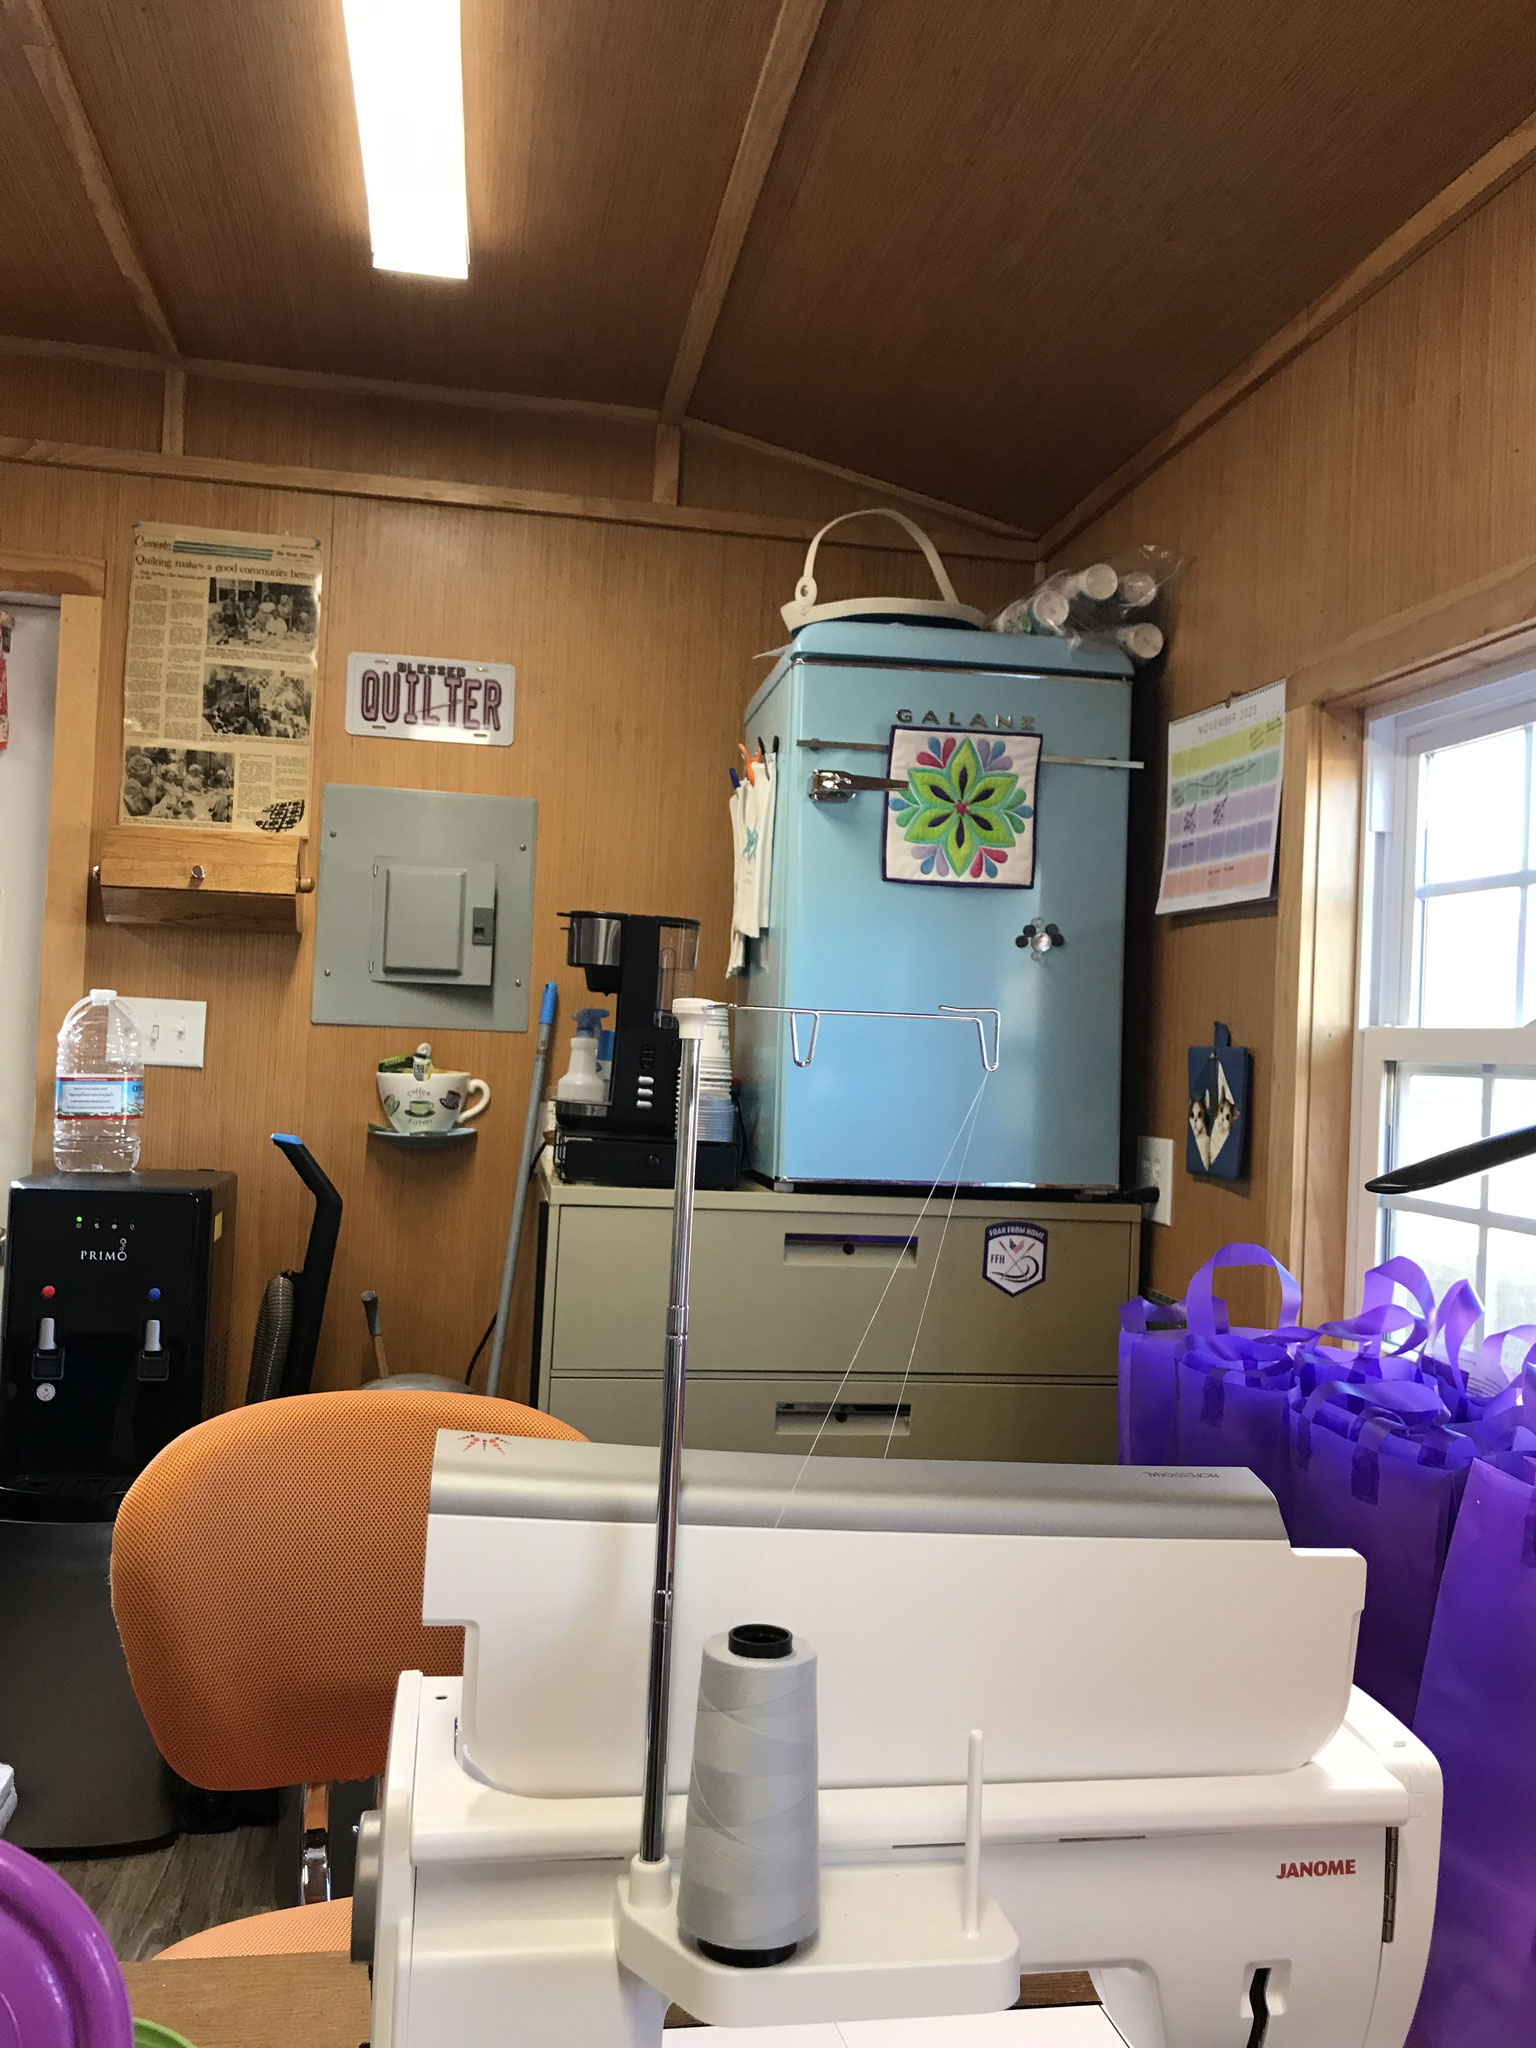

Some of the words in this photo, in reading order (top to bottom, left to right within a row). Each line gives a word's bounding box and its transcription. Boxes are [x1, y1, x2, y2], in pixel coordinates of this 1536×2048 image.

[136, 554, 172, 569] Quilting
[175, 560, 204, 570] makes
[215, 563, 237, 573] good
[239, 566, 288, 579] community
[291, 569, 315, 580] better
[397, 662, 466, 677] BLESSED
[361, 669, 502, 731] QUILTER
[896, 708, 1036, 731] GALANZ
[1198, 712, 1237, 735] NOVEMBER
[989, 1227, 1006, 1237] FOAR
[1007, 1225, 1026, 1234] FROM
[1026, 1228, 1045, 1240] HOME
[80, 1249, 127, 1262] PRIMO
[990, 1254, 1005, 1264] FFH
[1276, 1858, 1356, 1879] JANOME
